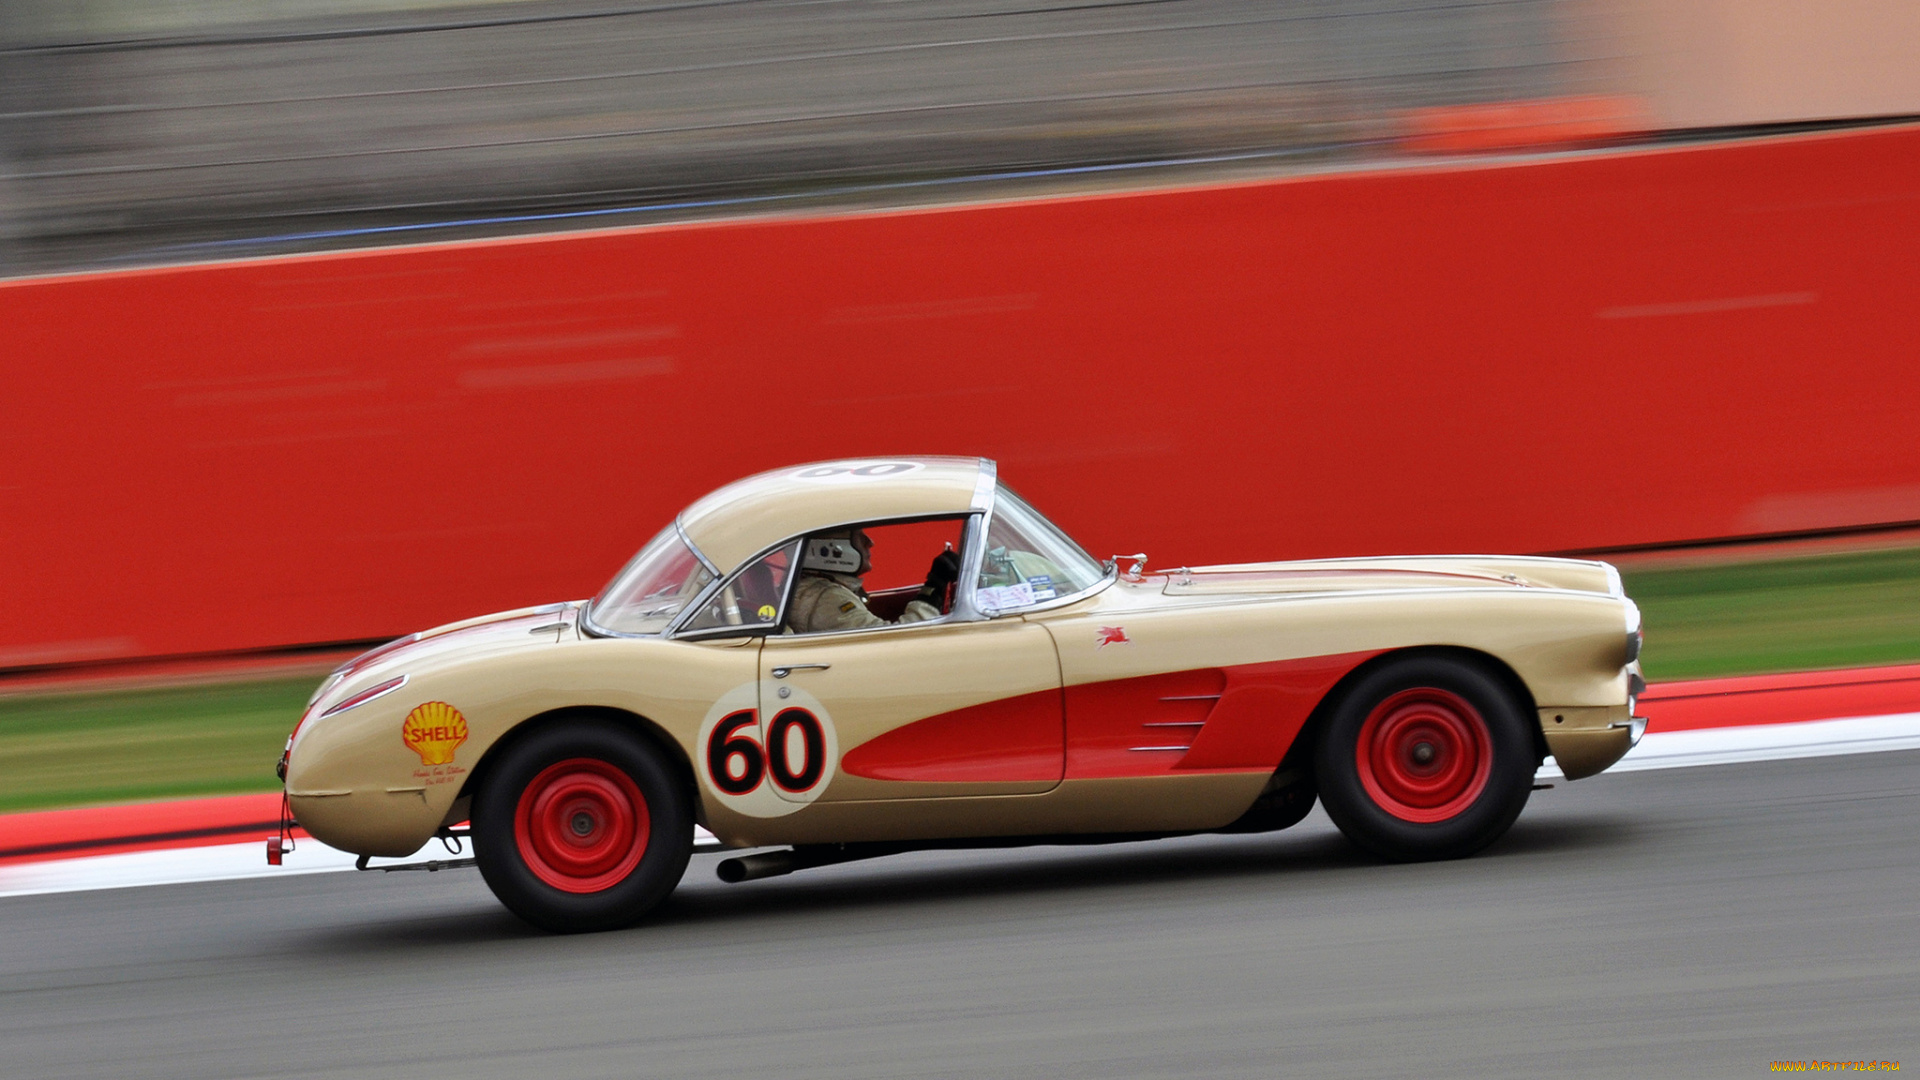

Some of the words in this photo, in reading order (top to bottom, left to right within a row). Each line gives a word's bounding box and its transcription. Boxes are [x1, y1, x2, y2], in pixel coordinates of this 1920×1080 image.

[797, 463, 916, 478] 60
[411, 726, 462, 743] SHELL
[706, 706, 827, 796] 60
